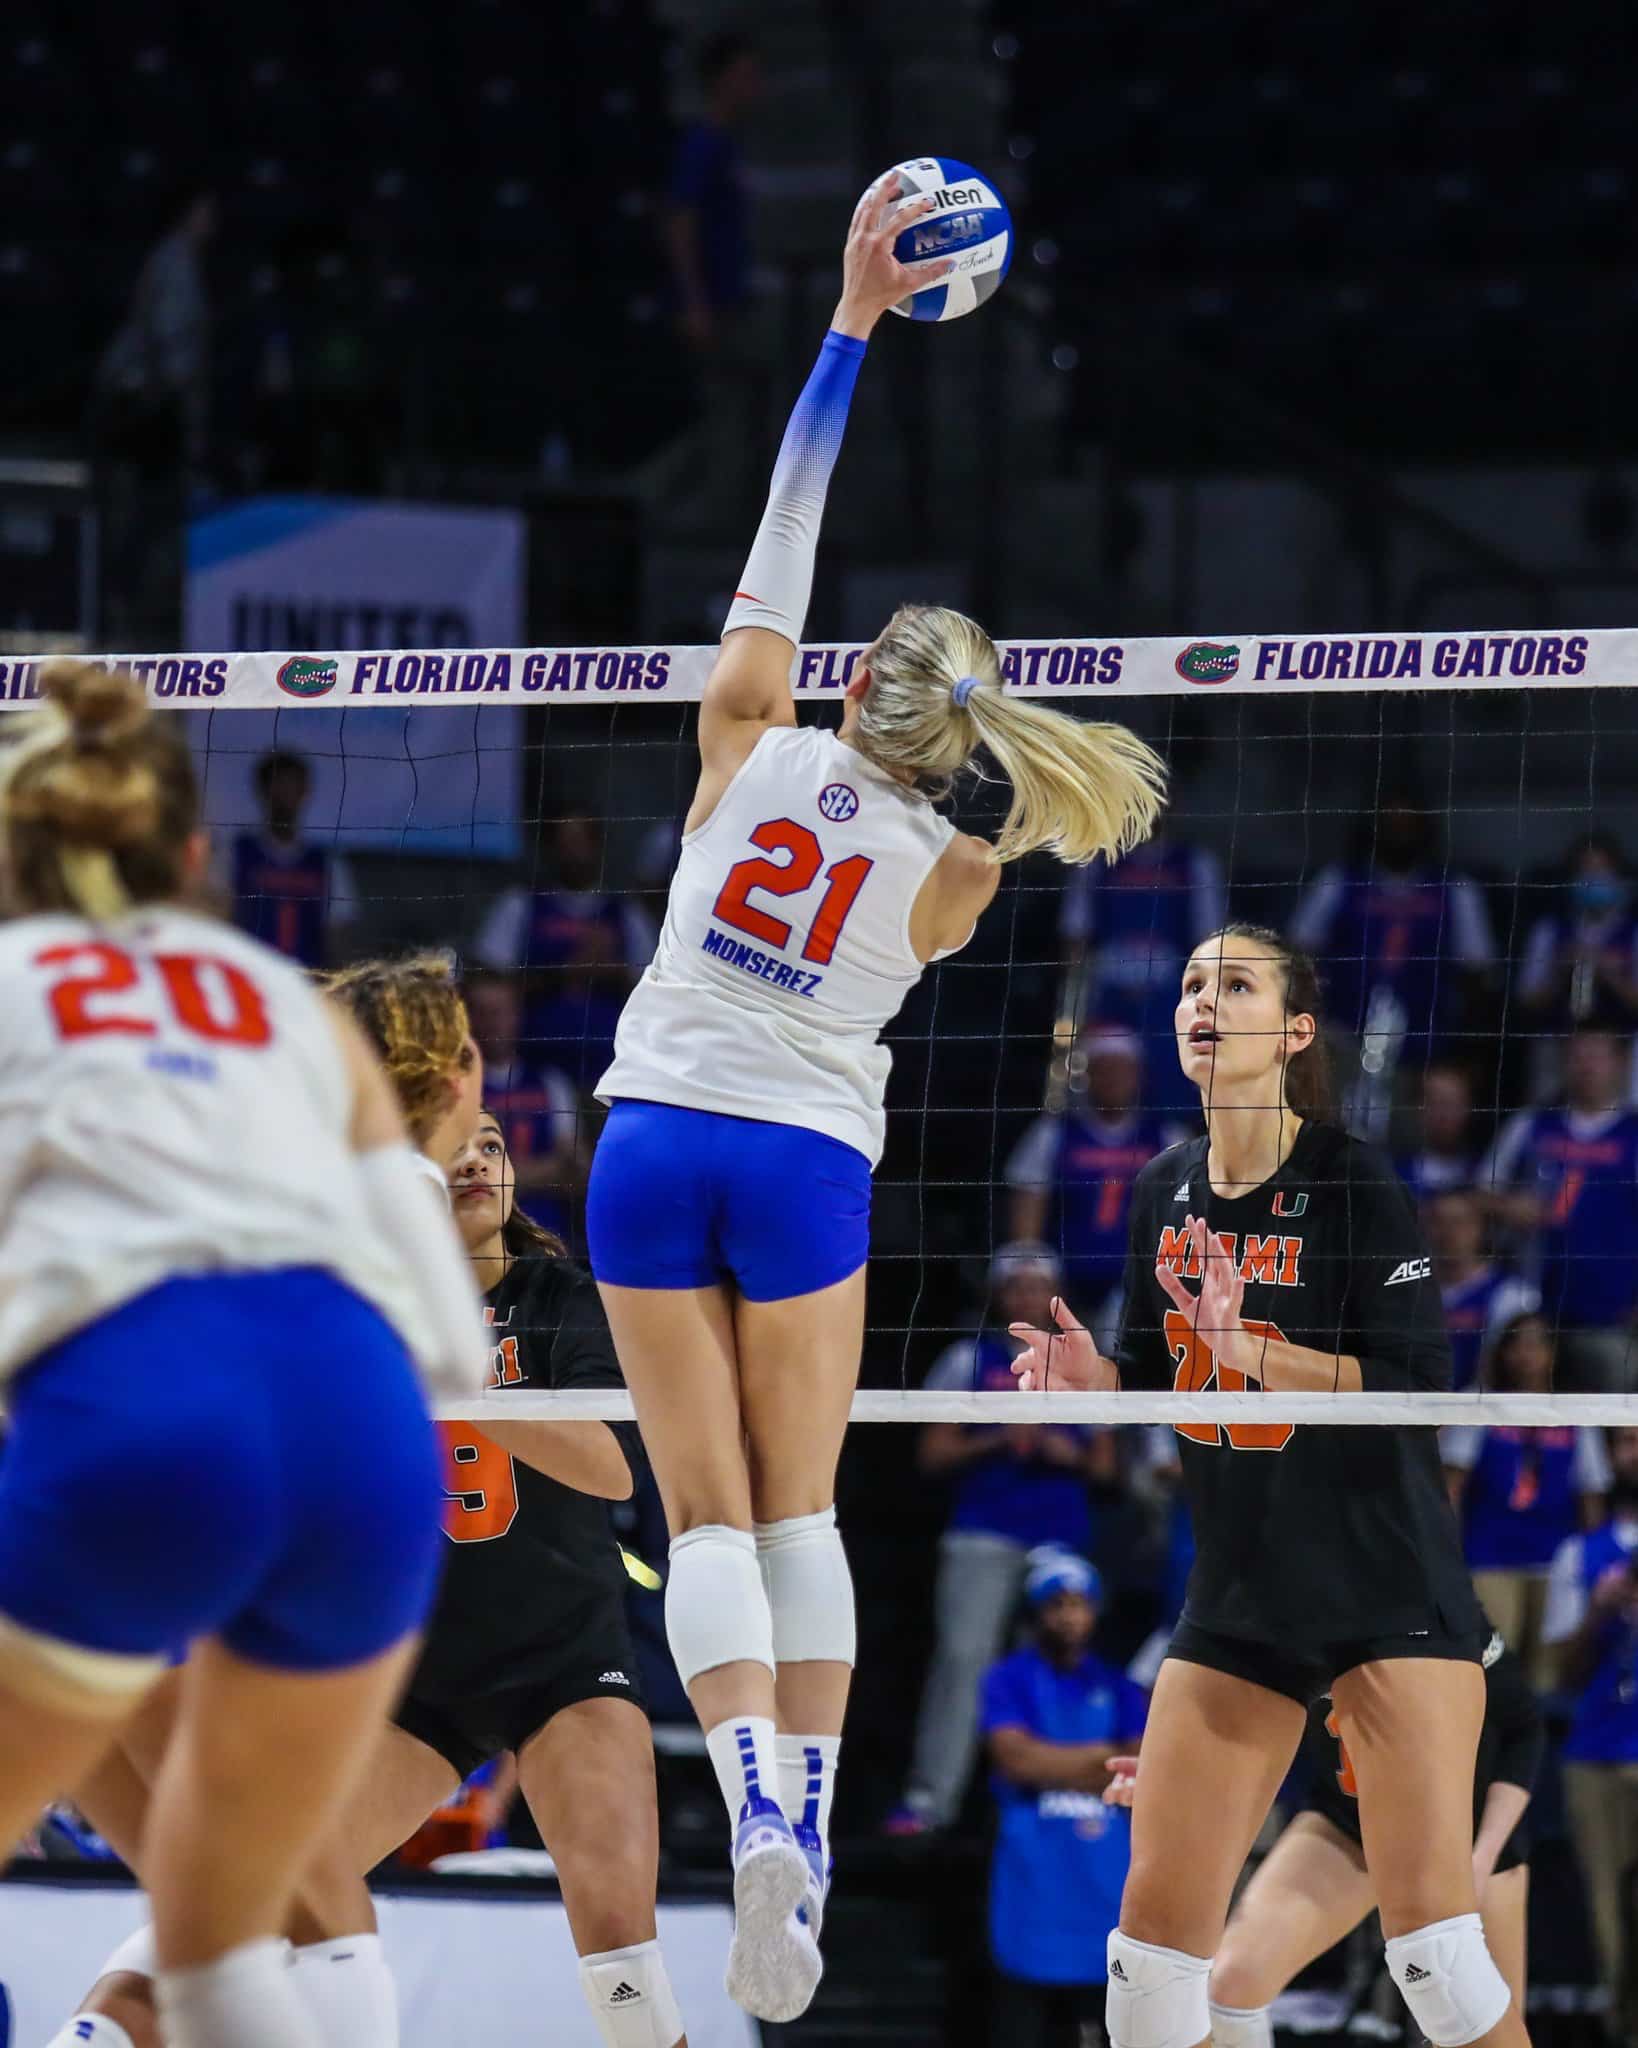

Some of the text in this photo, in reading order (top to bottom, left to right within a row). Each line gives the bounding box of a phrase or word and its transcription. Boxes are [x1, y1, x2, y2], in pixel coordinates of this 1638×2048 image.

[350, 652, 671, 694] FLORIDA GATORS
[1000, 646, 1123, 687] ATORS
[1253, 636, 1588, 681] FLORIDA GATORS
[712, 817, 874, 967] 21
[701, 927, 822, 998] MONSEREZ
[32, 940, 272, 1052] 20
